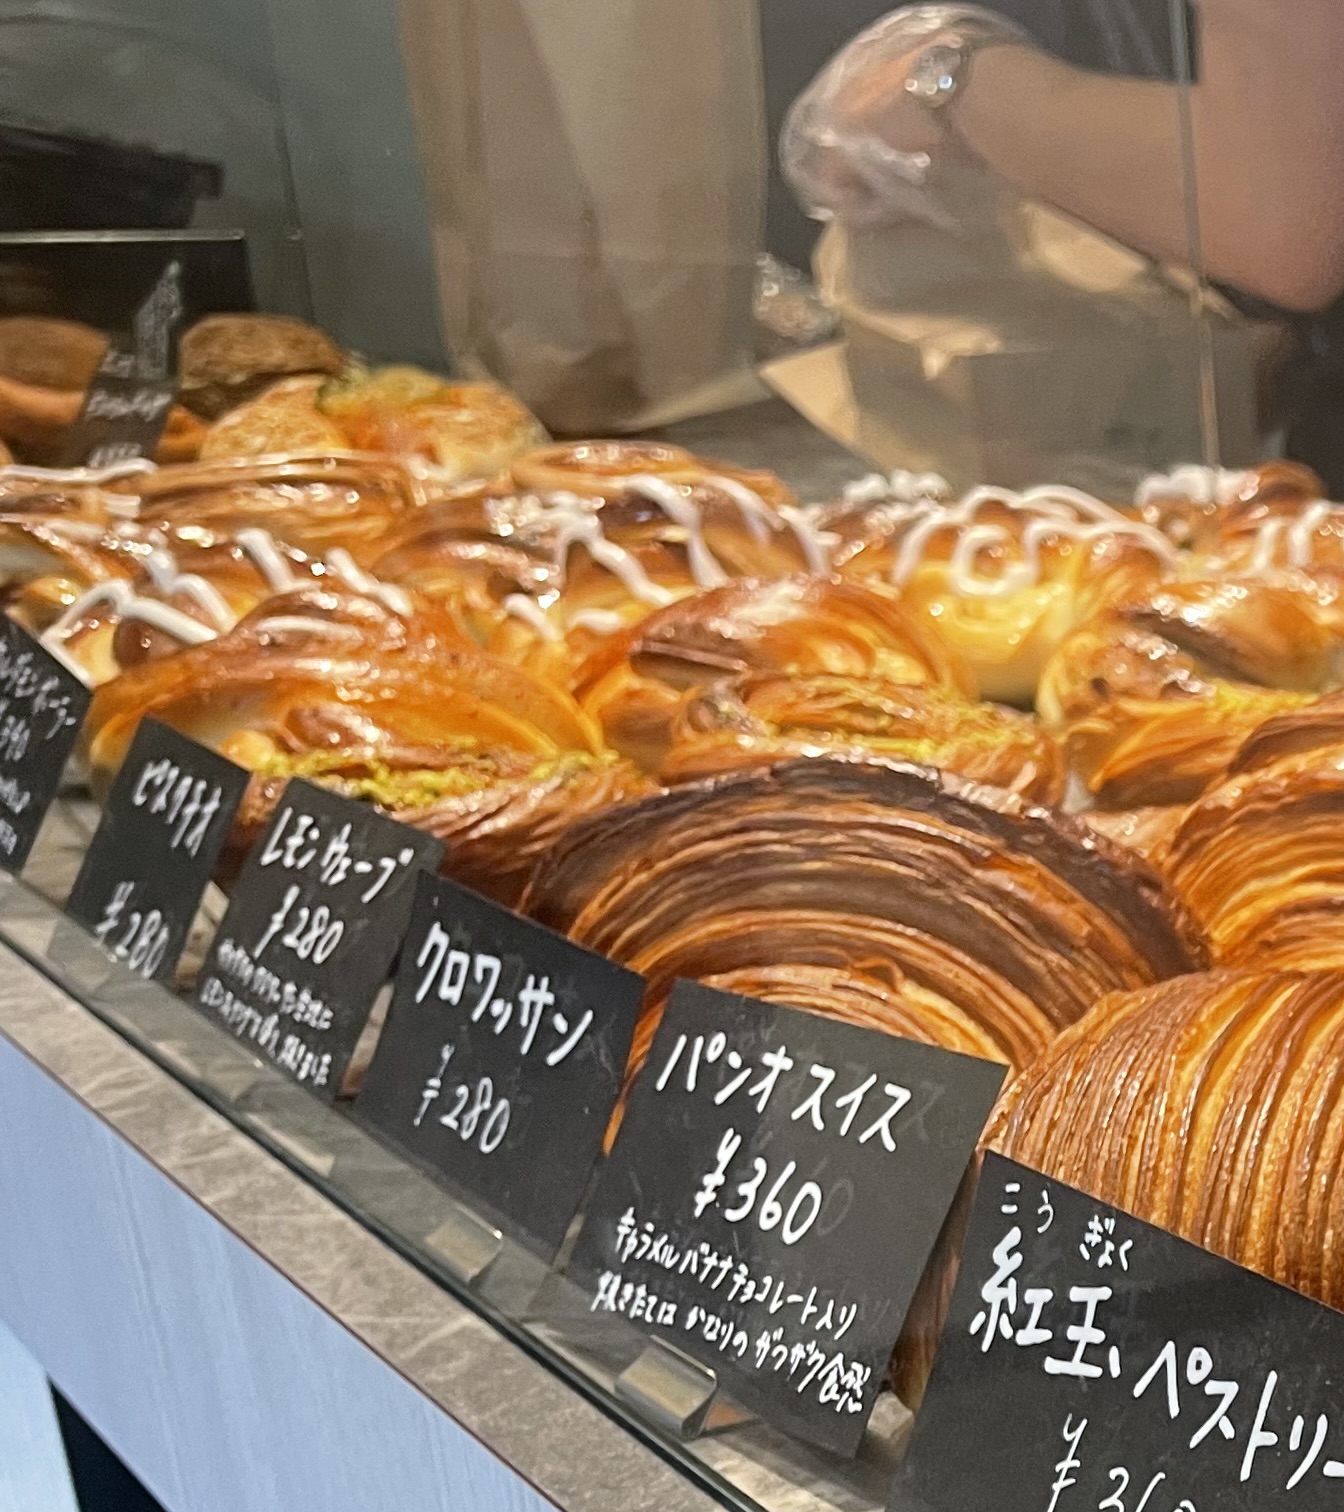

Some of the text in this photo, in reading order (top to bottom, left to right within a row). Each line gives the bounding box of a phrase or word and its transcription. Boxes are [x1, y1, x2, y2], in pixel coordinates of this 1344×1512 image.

[254, 884, 346, 965] ¥280
[414, 920, 594, 1066] クロワッサン
[413, 1042, 511, 1154] ¥280
[694, 1128, 822, 1245] ¥360
